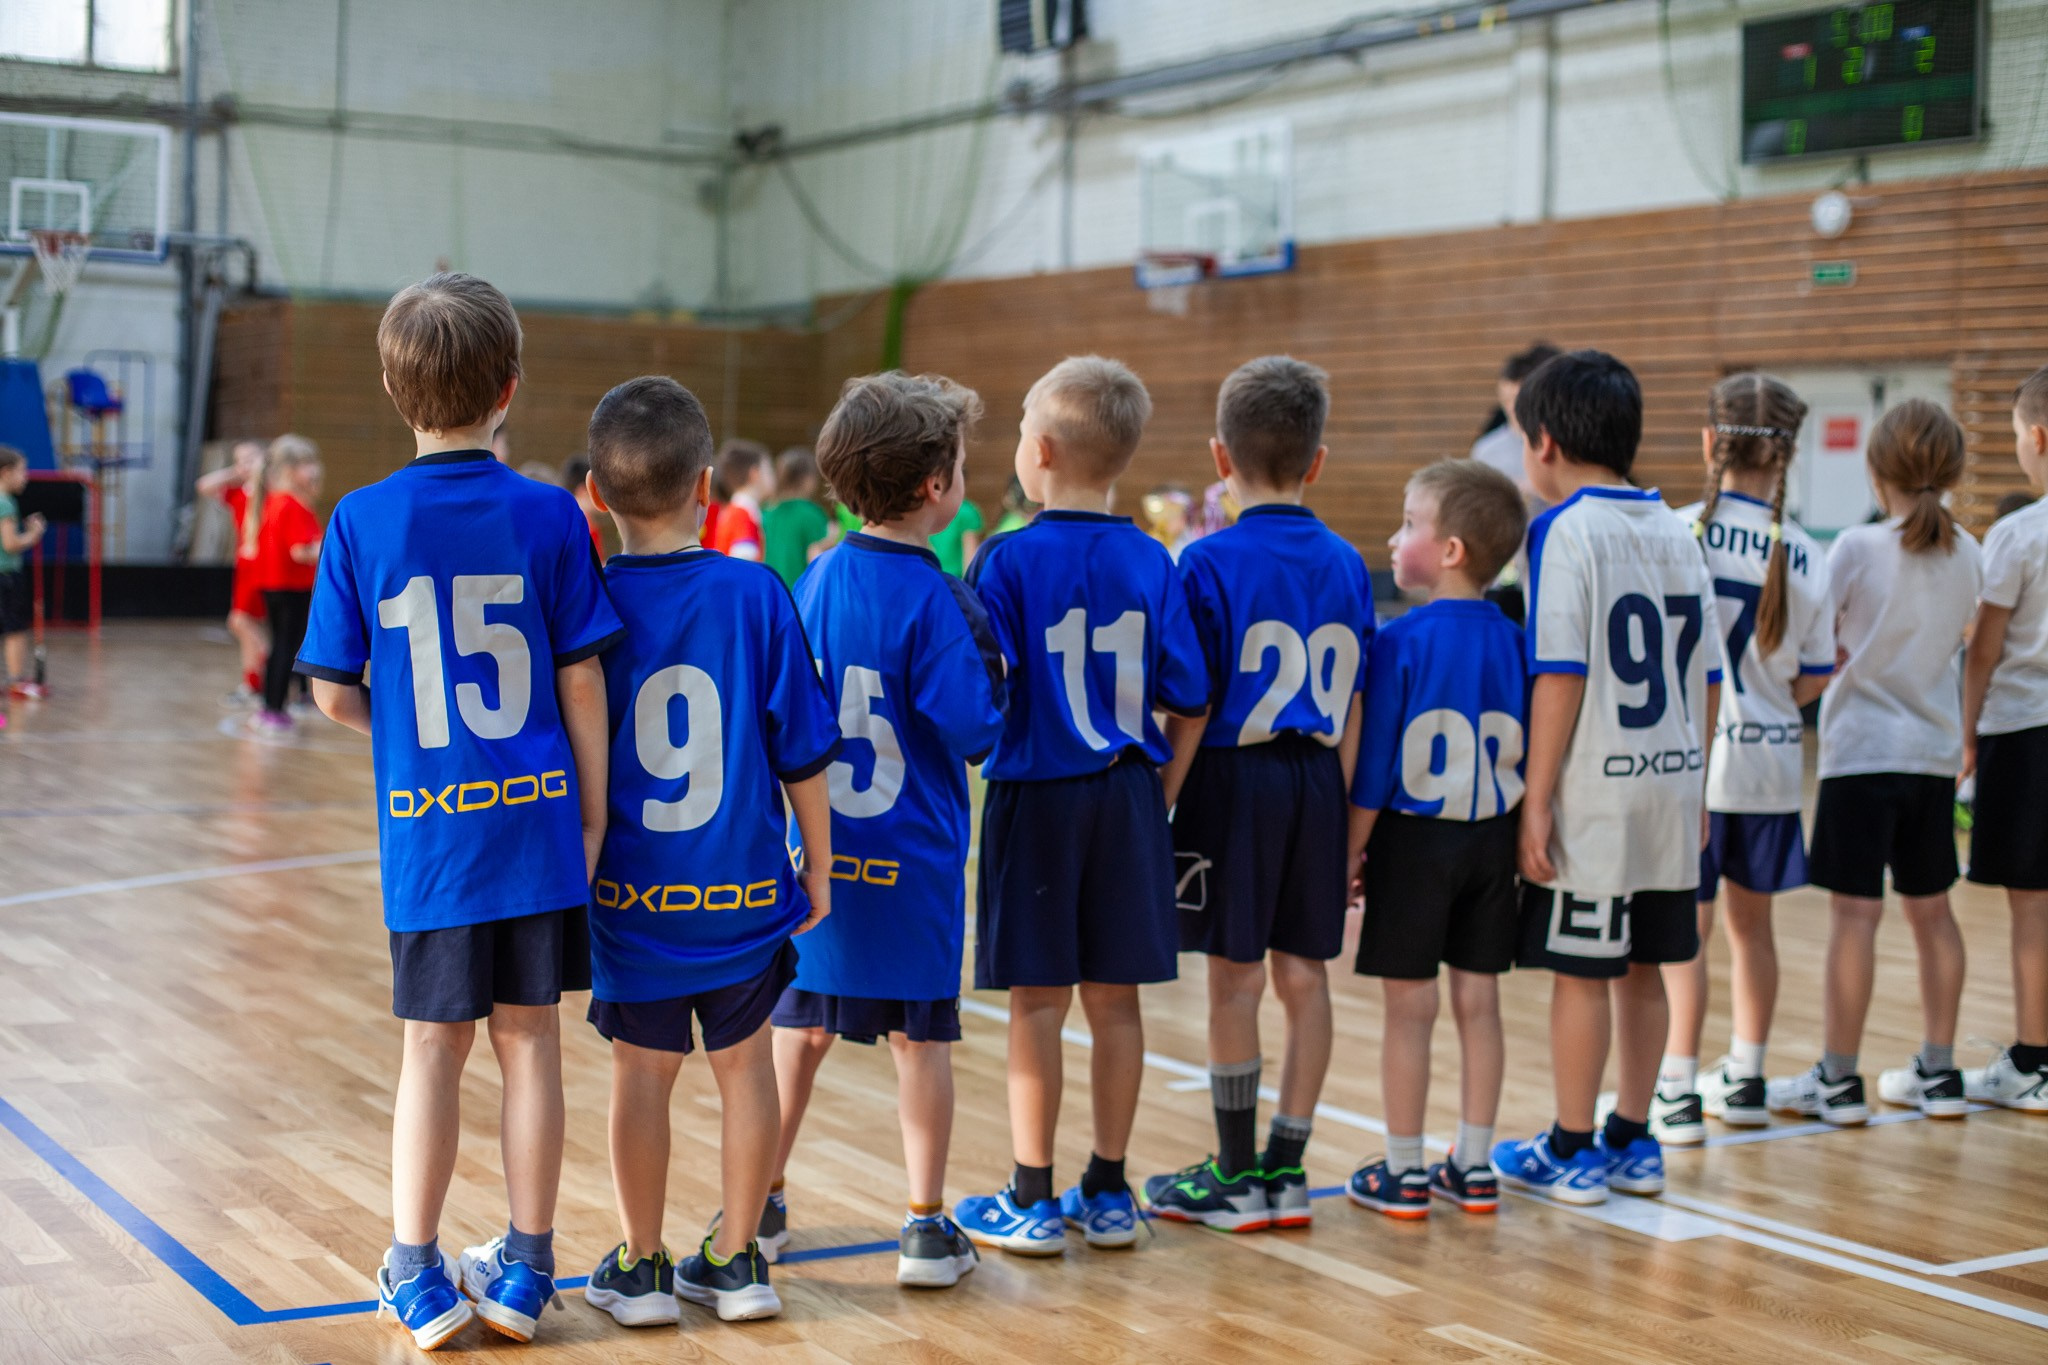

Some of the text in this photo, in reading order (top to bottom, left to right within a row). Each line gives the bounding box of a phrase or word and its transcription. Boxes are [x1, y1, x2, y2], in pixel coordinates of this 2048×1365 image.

[378, 574, 531, 748] 15
[1046, 608, 1146, 751] 11
[1238, 620, 1360, 748] 29
[1607, 593, 1703, 729] 97
[389, 769, 568, 818] OXDOG
[634, 664, 723, 832] 9
[816, 659, 906, 819] 5
[1603, 746, 1704, 777] OXDO
[595, 879, 777, 913] OXDOG
